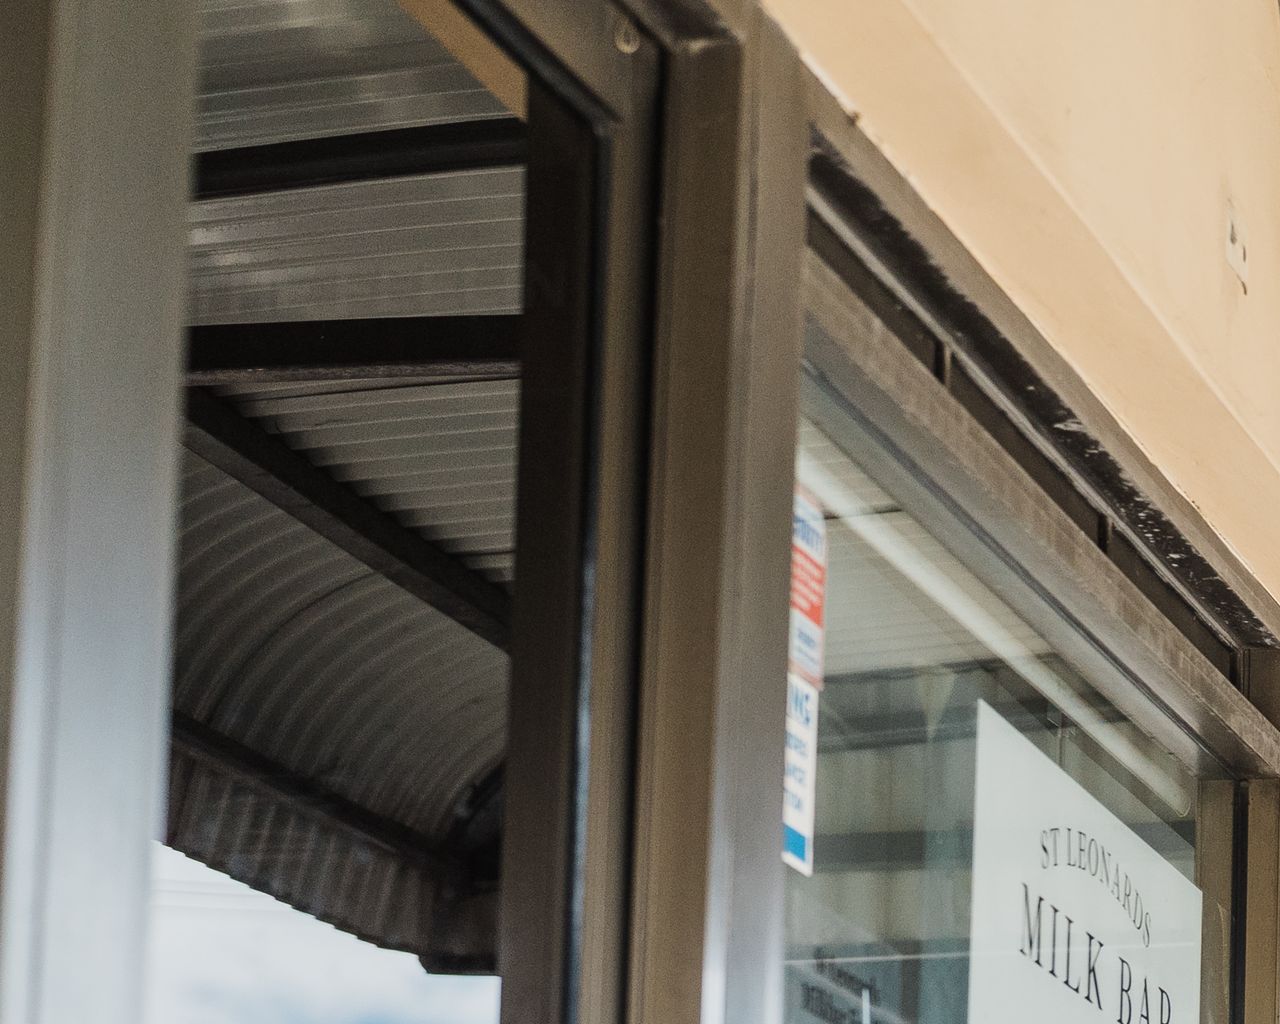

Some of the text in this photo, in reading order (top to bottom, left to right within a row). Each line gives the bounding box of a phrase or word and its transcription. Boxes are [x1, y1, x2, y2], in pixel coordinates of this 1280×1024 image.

[1018, 881, 1105, 1011] MILK
[1039, 826, 1152, 948] ST LEONARDS
